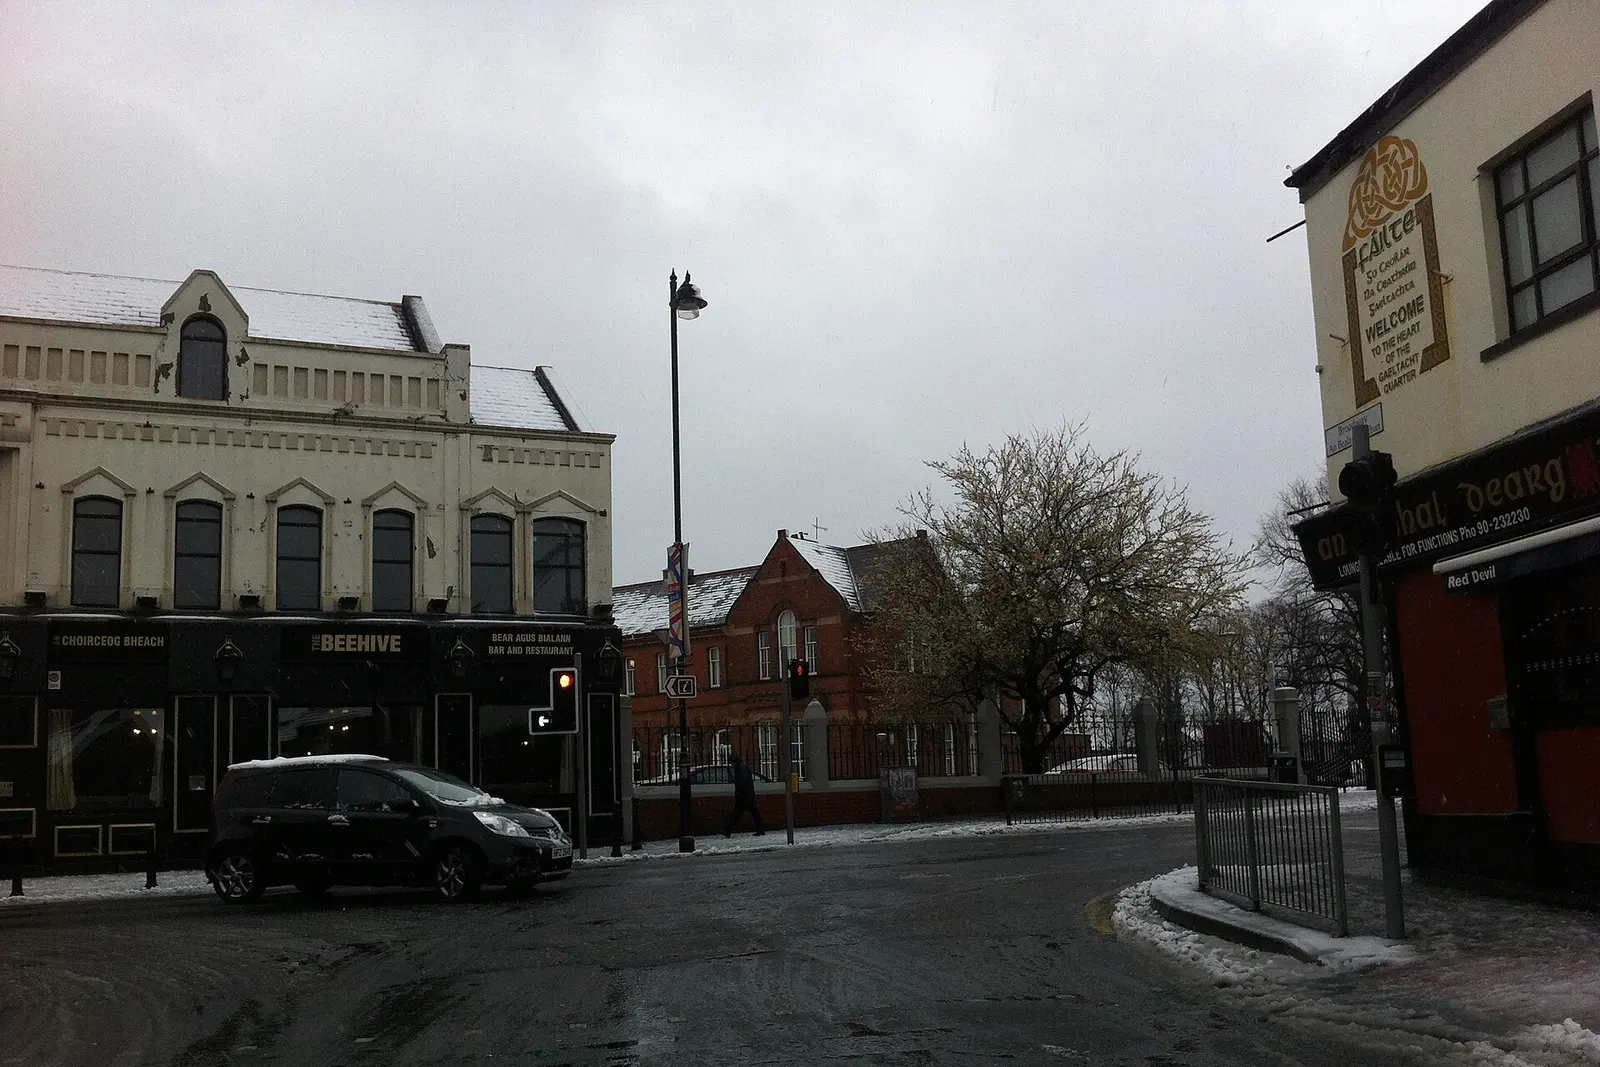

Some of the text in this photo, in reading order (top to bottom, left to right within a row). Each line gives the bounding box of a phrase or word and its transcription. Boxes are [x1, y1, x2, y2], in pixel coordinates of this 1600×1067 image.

[1365, 294, 1425, 344] WELCOME
[1371, 321, 1421, 358] TO THE HEART
[1385, 342, 1411, 365] OF THE
[1378, 352, 1420, 382] GAELTACHT
[1383, 369, 1417, 394] QUARTER
[1338, 560, 1361, 577] LOUNG
[1401, 543, 1418, 559] FOR
[1418, 530, 1459, 555] FUNCTIONS
[1459, 525, 1476, 542] Pho
[1476, 507, 1531, 536] 90-232230
[1447, 564, 1496, 589] Red Devil
[62, 635, 120, 646] CHOIRCEOG
[124, 636, 164, 647] BHEACH
[312, 634, 401, 652] THE BEEHIVE
[489, 645, 574, 655] BAR AND RESTAURANT
[492, 633, 571, 643] BEAR AGUS BIALANN
